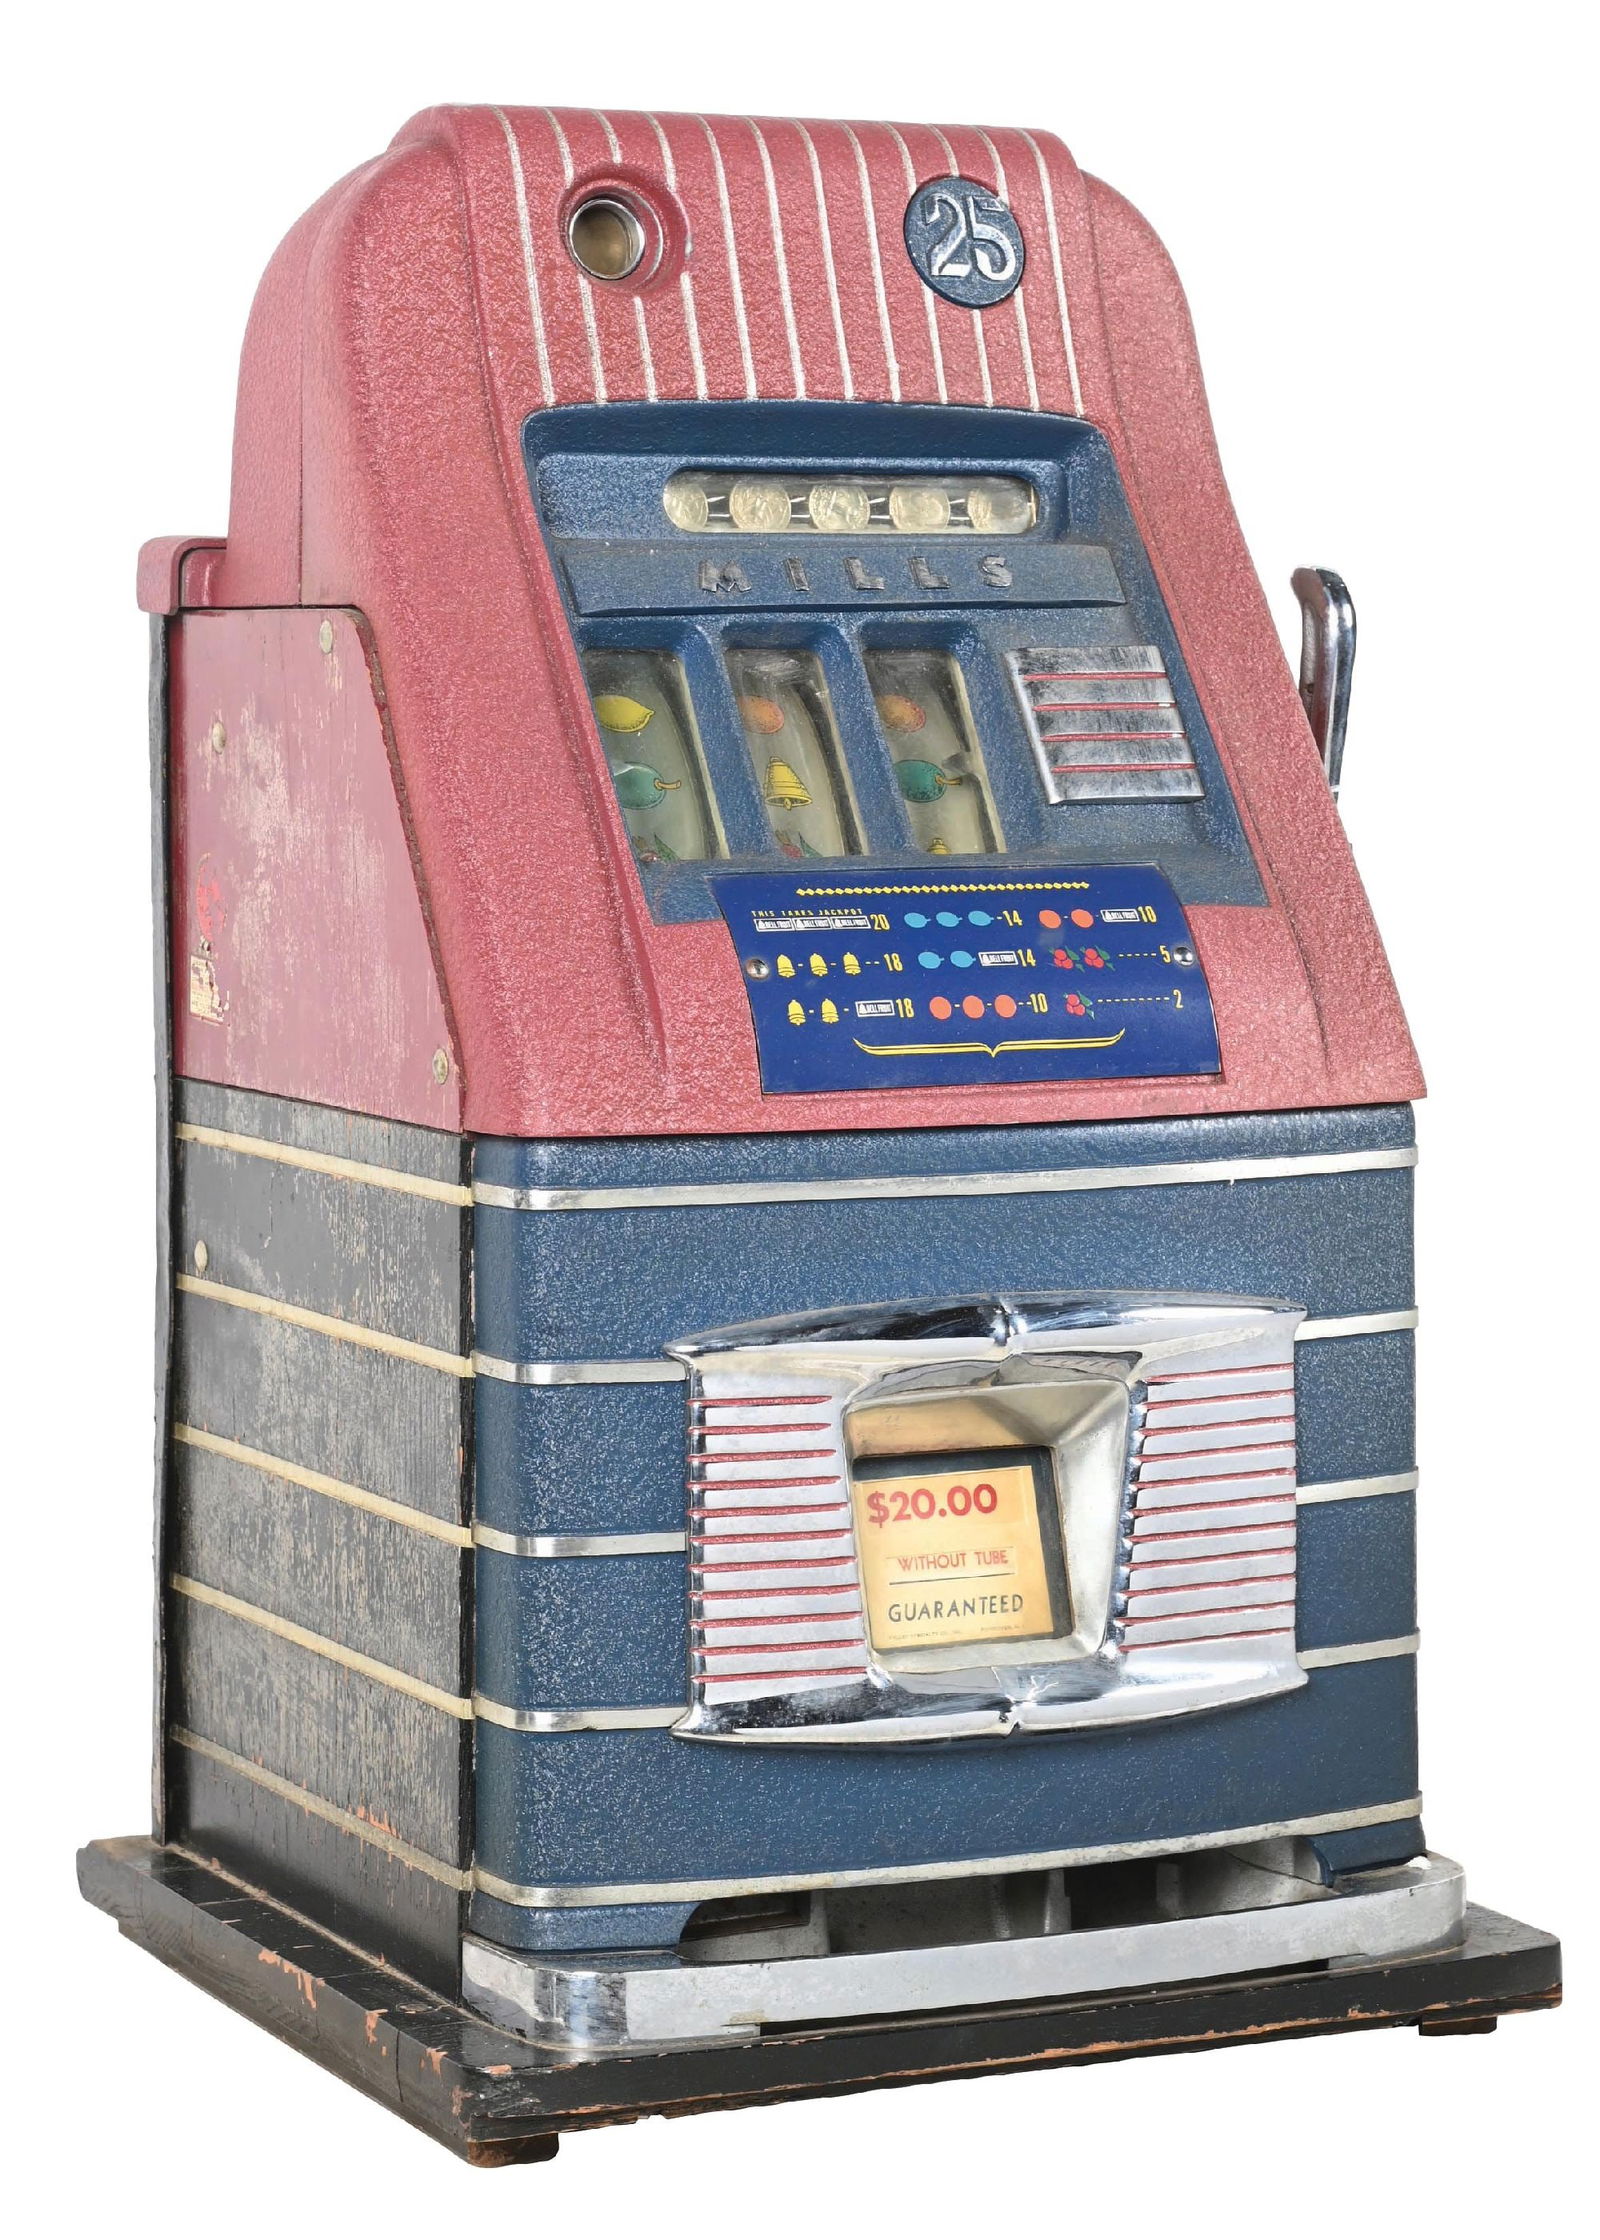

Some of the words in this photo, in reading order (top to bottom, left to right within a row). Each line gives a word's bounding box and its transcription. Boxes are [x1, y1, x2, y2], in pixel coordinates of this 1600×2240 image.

[923, 190, 1018, 282] 25
[699, 554, 1014, 593] MILLS
[781, 909, 814, 917] TAKES
[818, 908, 863, 916] JACKPOT
[869, 914, 891, 931] 20
[1002, 910, 1023, 927] 14
[1137, 905, 1157, 923] 10
[883, 953, 903, 971] 18
[1017, 949, 1036, 967] 14
[1159, 945, 1171, 963] 5
[896, 997, 915, 1018] 18
[1029, 993, 1048, 1013] 10
[1172, 989, 1184, 1009] 2
[866, 1482, 998, 1529] $20.00
[896, 1552, 967, 1573] WITHOUT
[976, 1549, 1009, 1566] TUBE
[887, 1593, 1024, 1624] GUARANTEED
